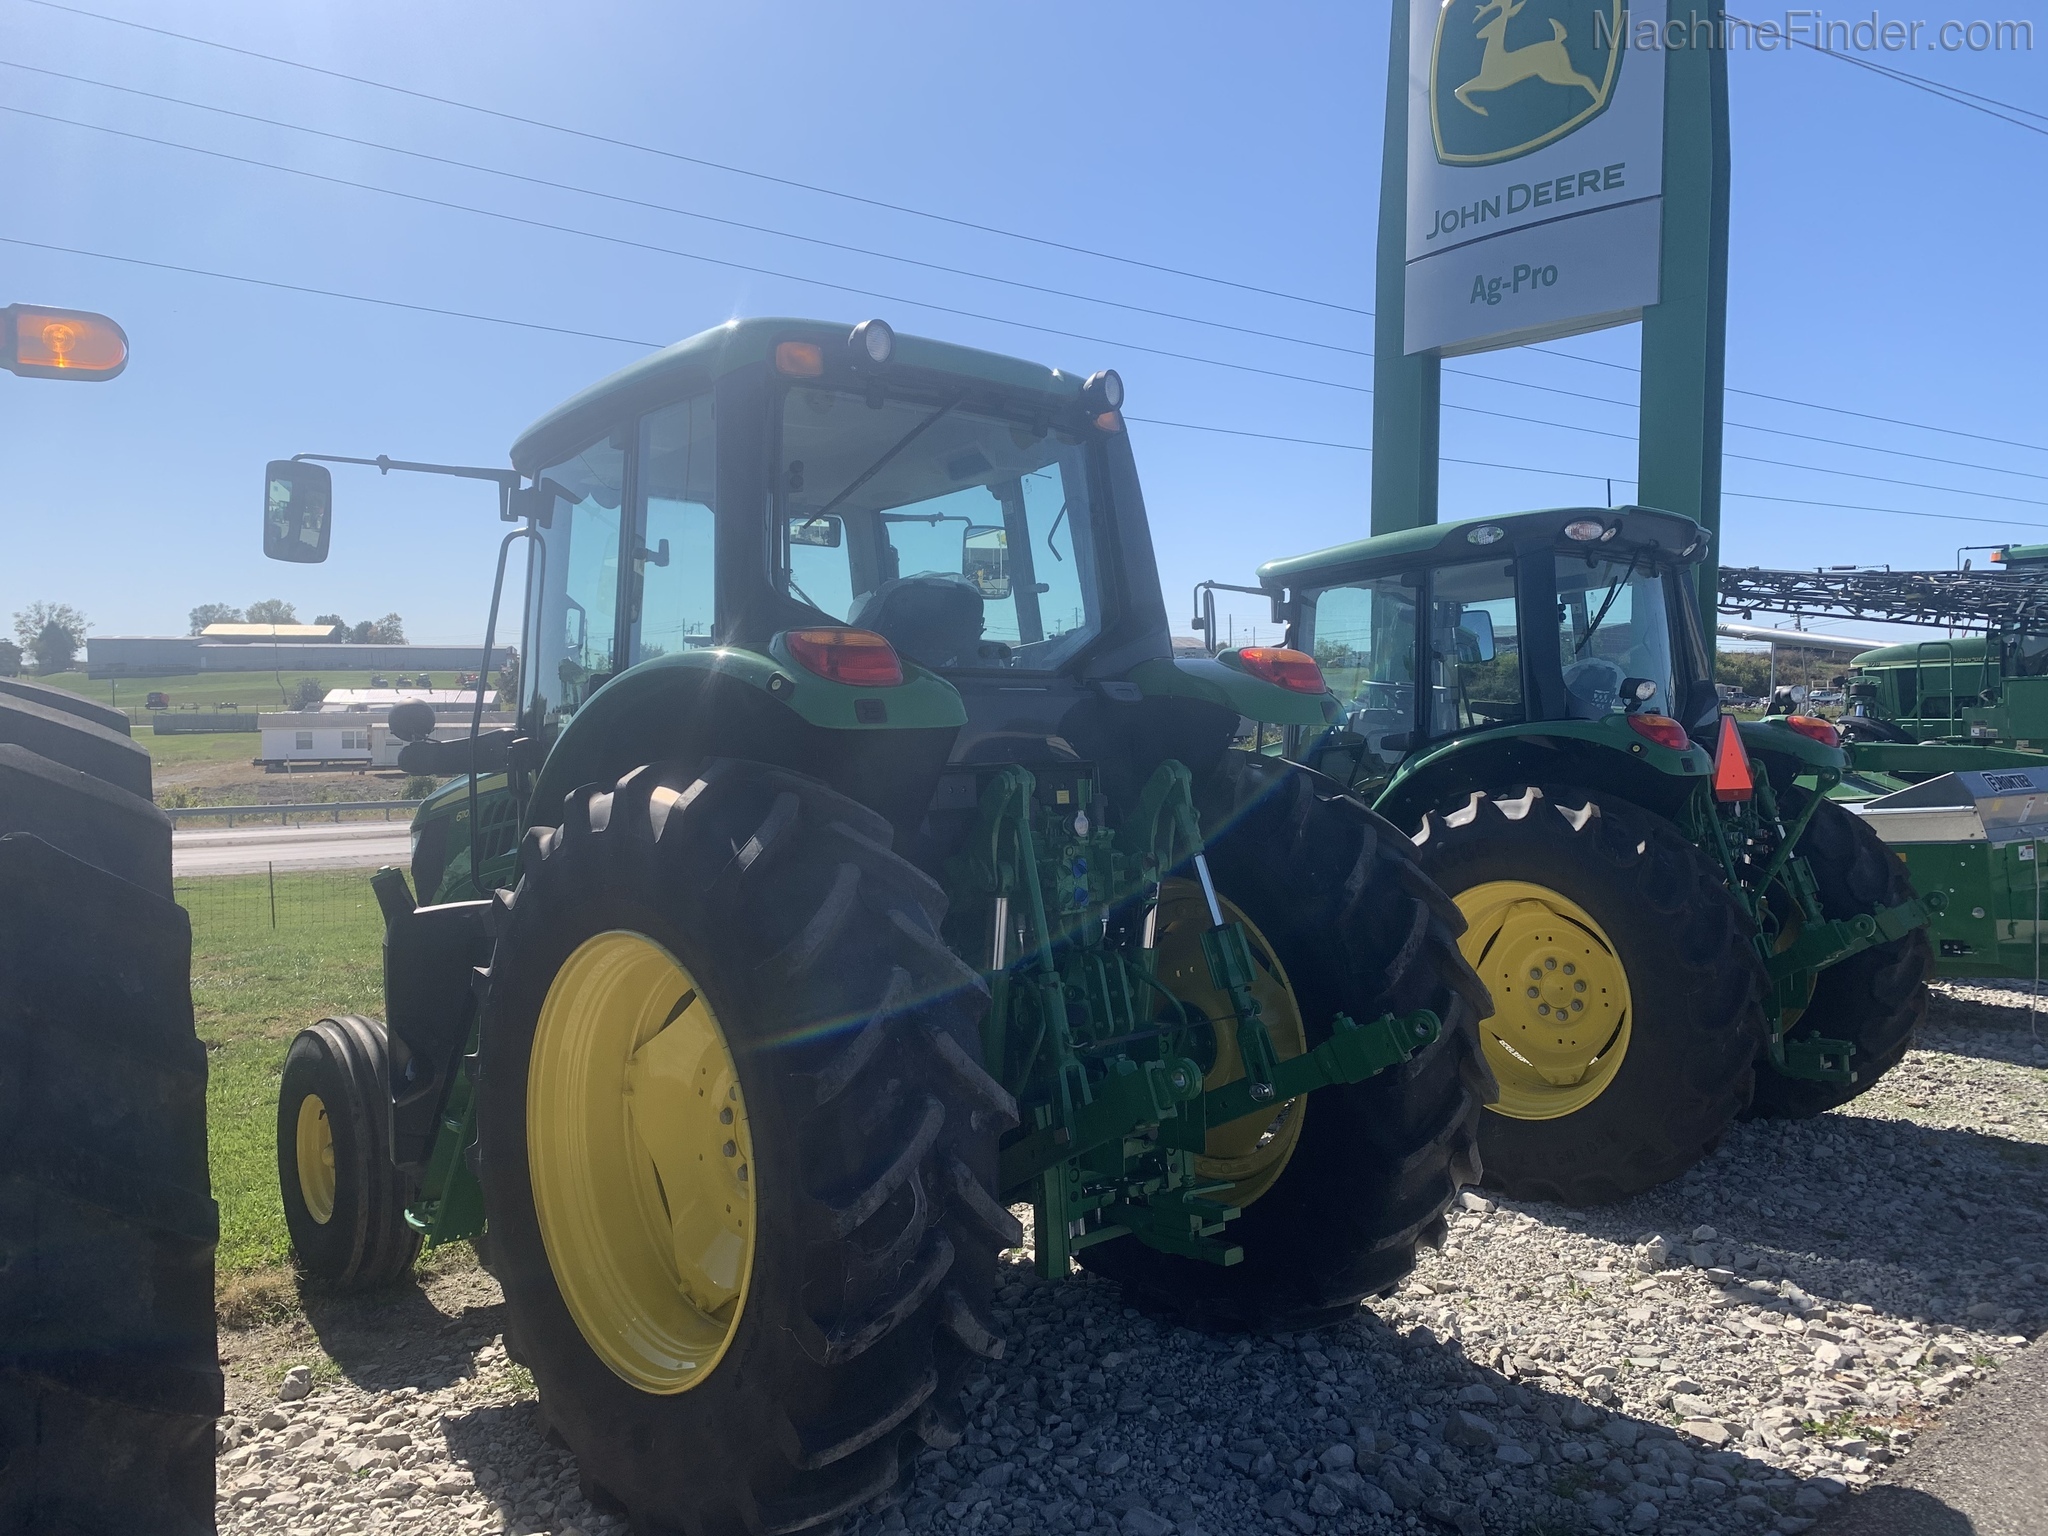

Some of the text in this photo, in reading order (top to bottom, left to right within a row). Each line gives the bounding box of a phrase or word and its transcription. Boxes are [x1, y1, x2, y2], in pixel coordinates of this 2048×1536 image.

[1426, 162, 1625, 240] JOHN DEERE
[1470, 263, 1558, 306] Ag-Pro
[1981, 773, 2036, 793] FRONTIER
